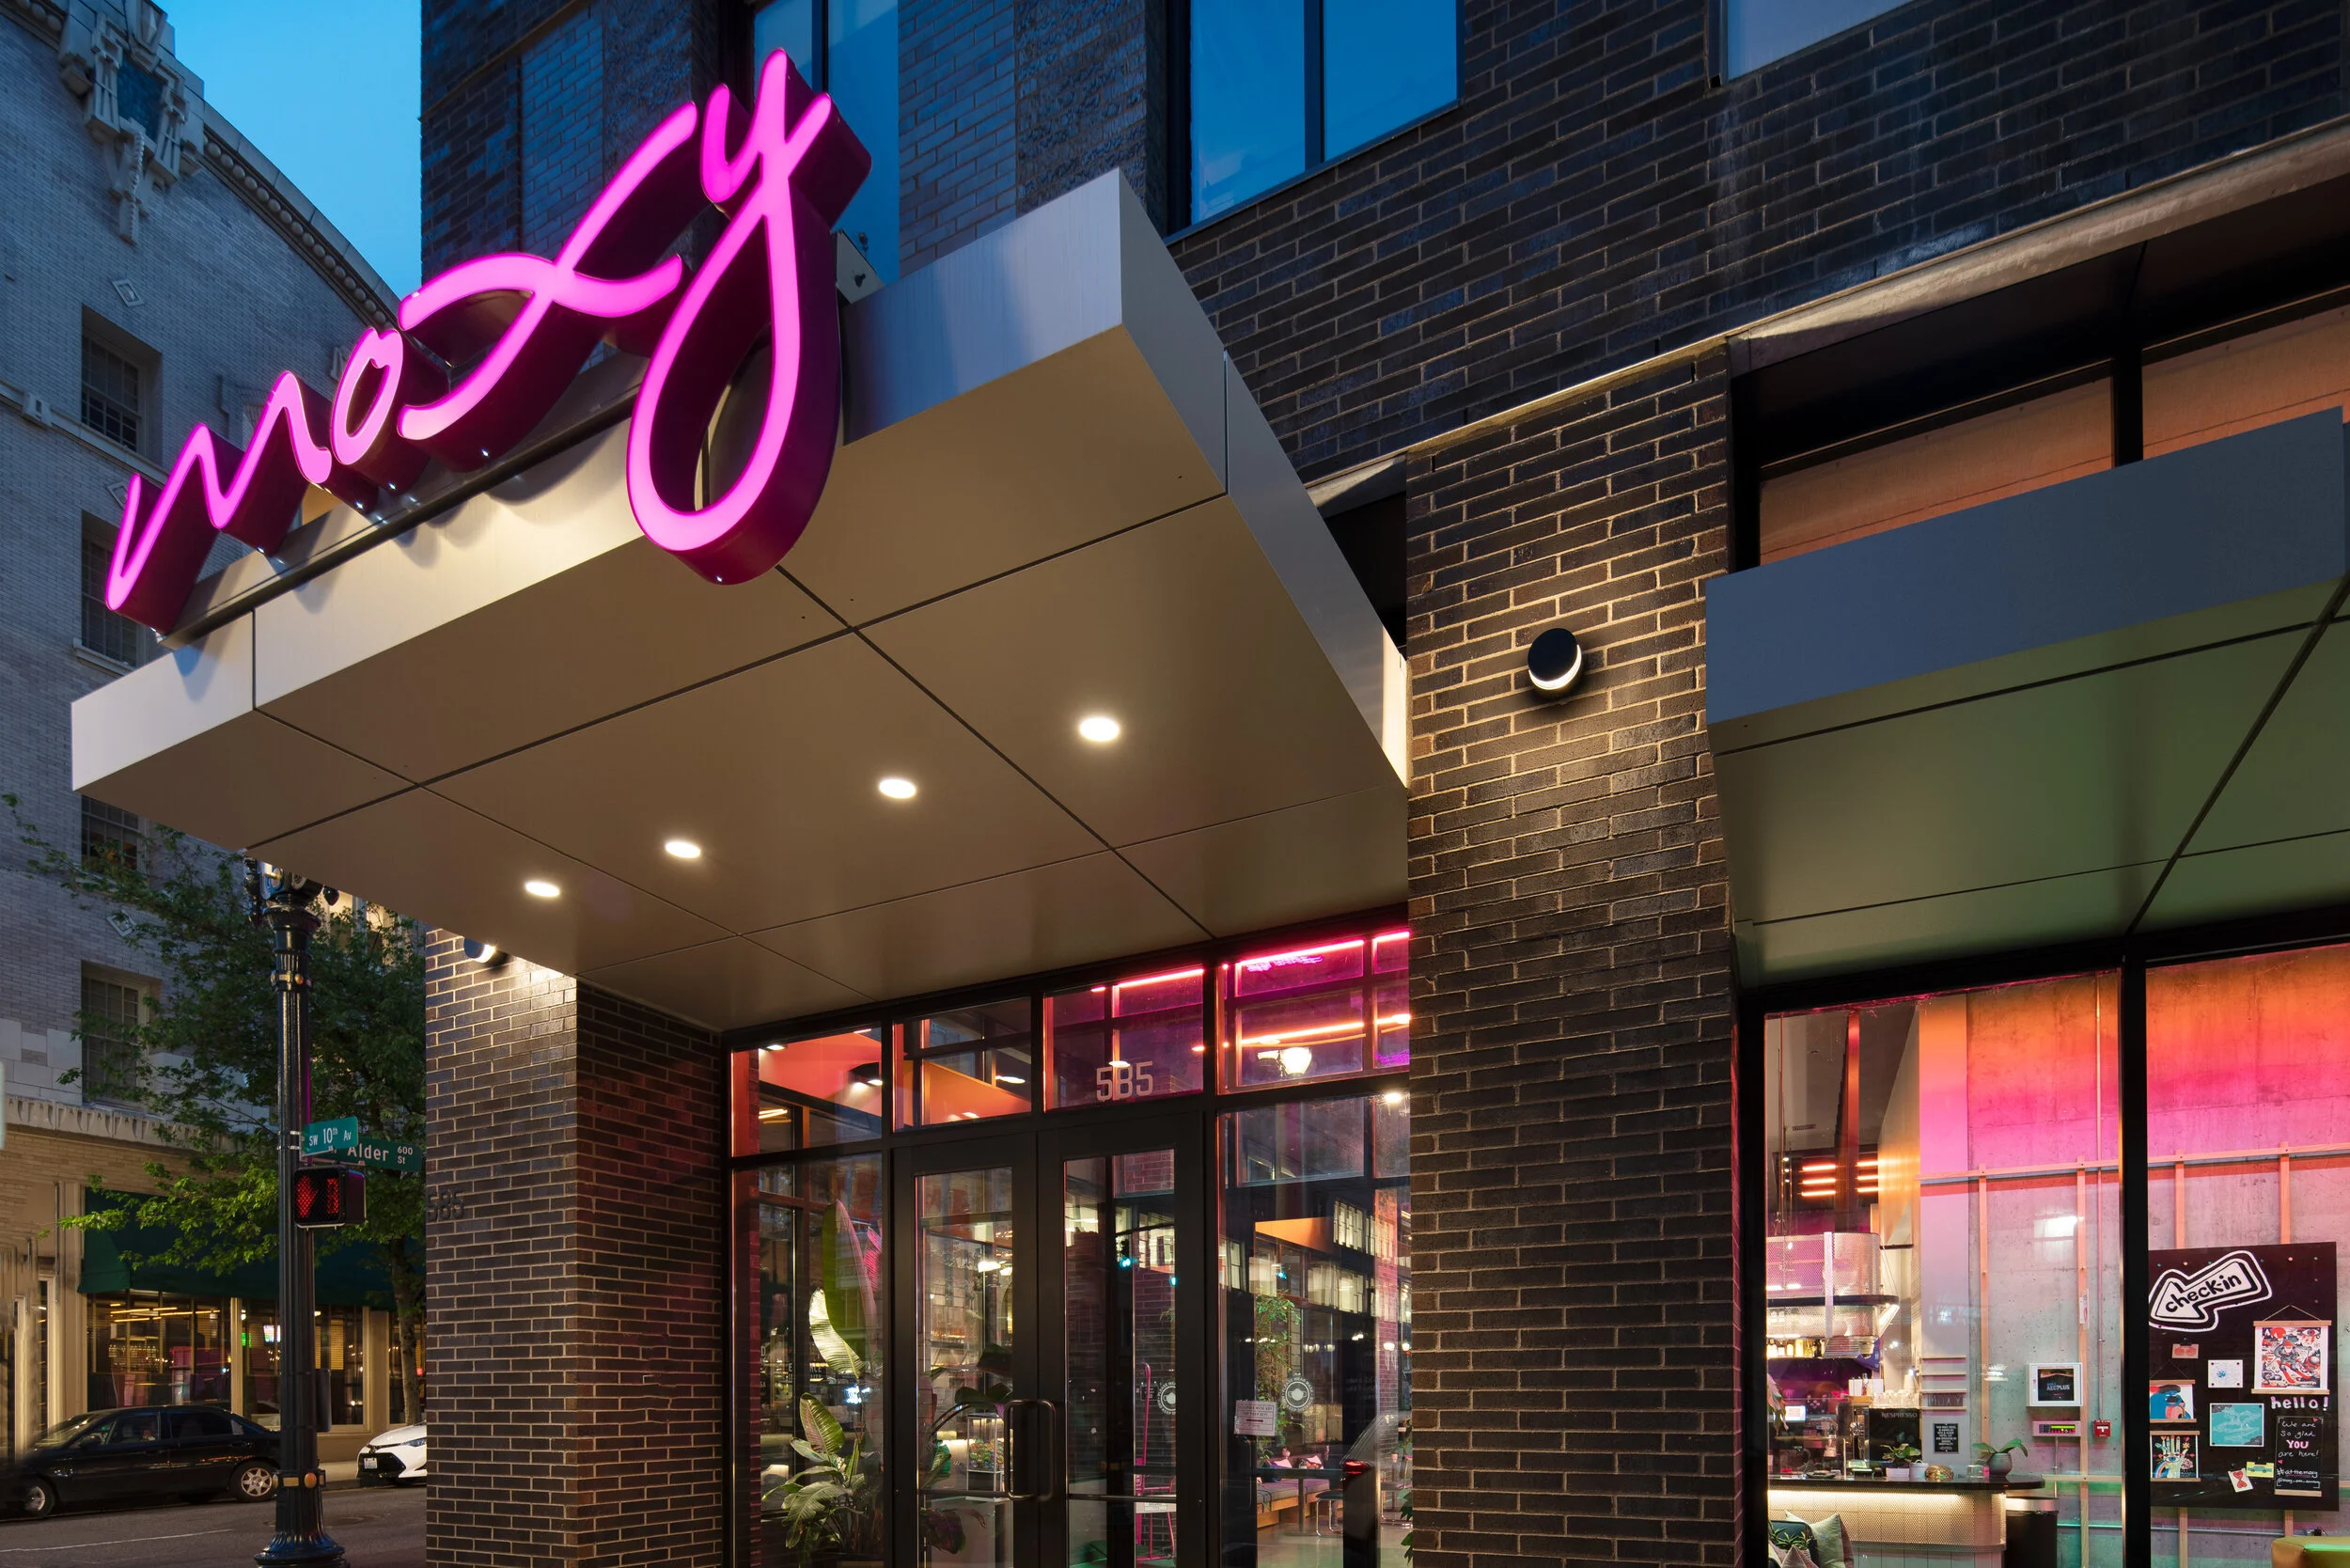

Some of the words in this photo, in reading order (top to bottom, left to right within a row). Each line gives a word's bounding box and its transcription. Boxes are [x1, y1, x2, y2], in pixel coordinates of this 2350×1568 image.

[1096, 1061, 1153, 1102] 585
[308, 1135, 318, 1147] SW
[343, 1130, 352, 1141] Av
[347, 1143, 389, 1162] Alder
[398, 1156, 406, 1165] St
[398, 1146, 414, 1156] 600
[2271, 1396, 2328, 1411] hello!
[2286, 1439, 2310, 1449] YOU
